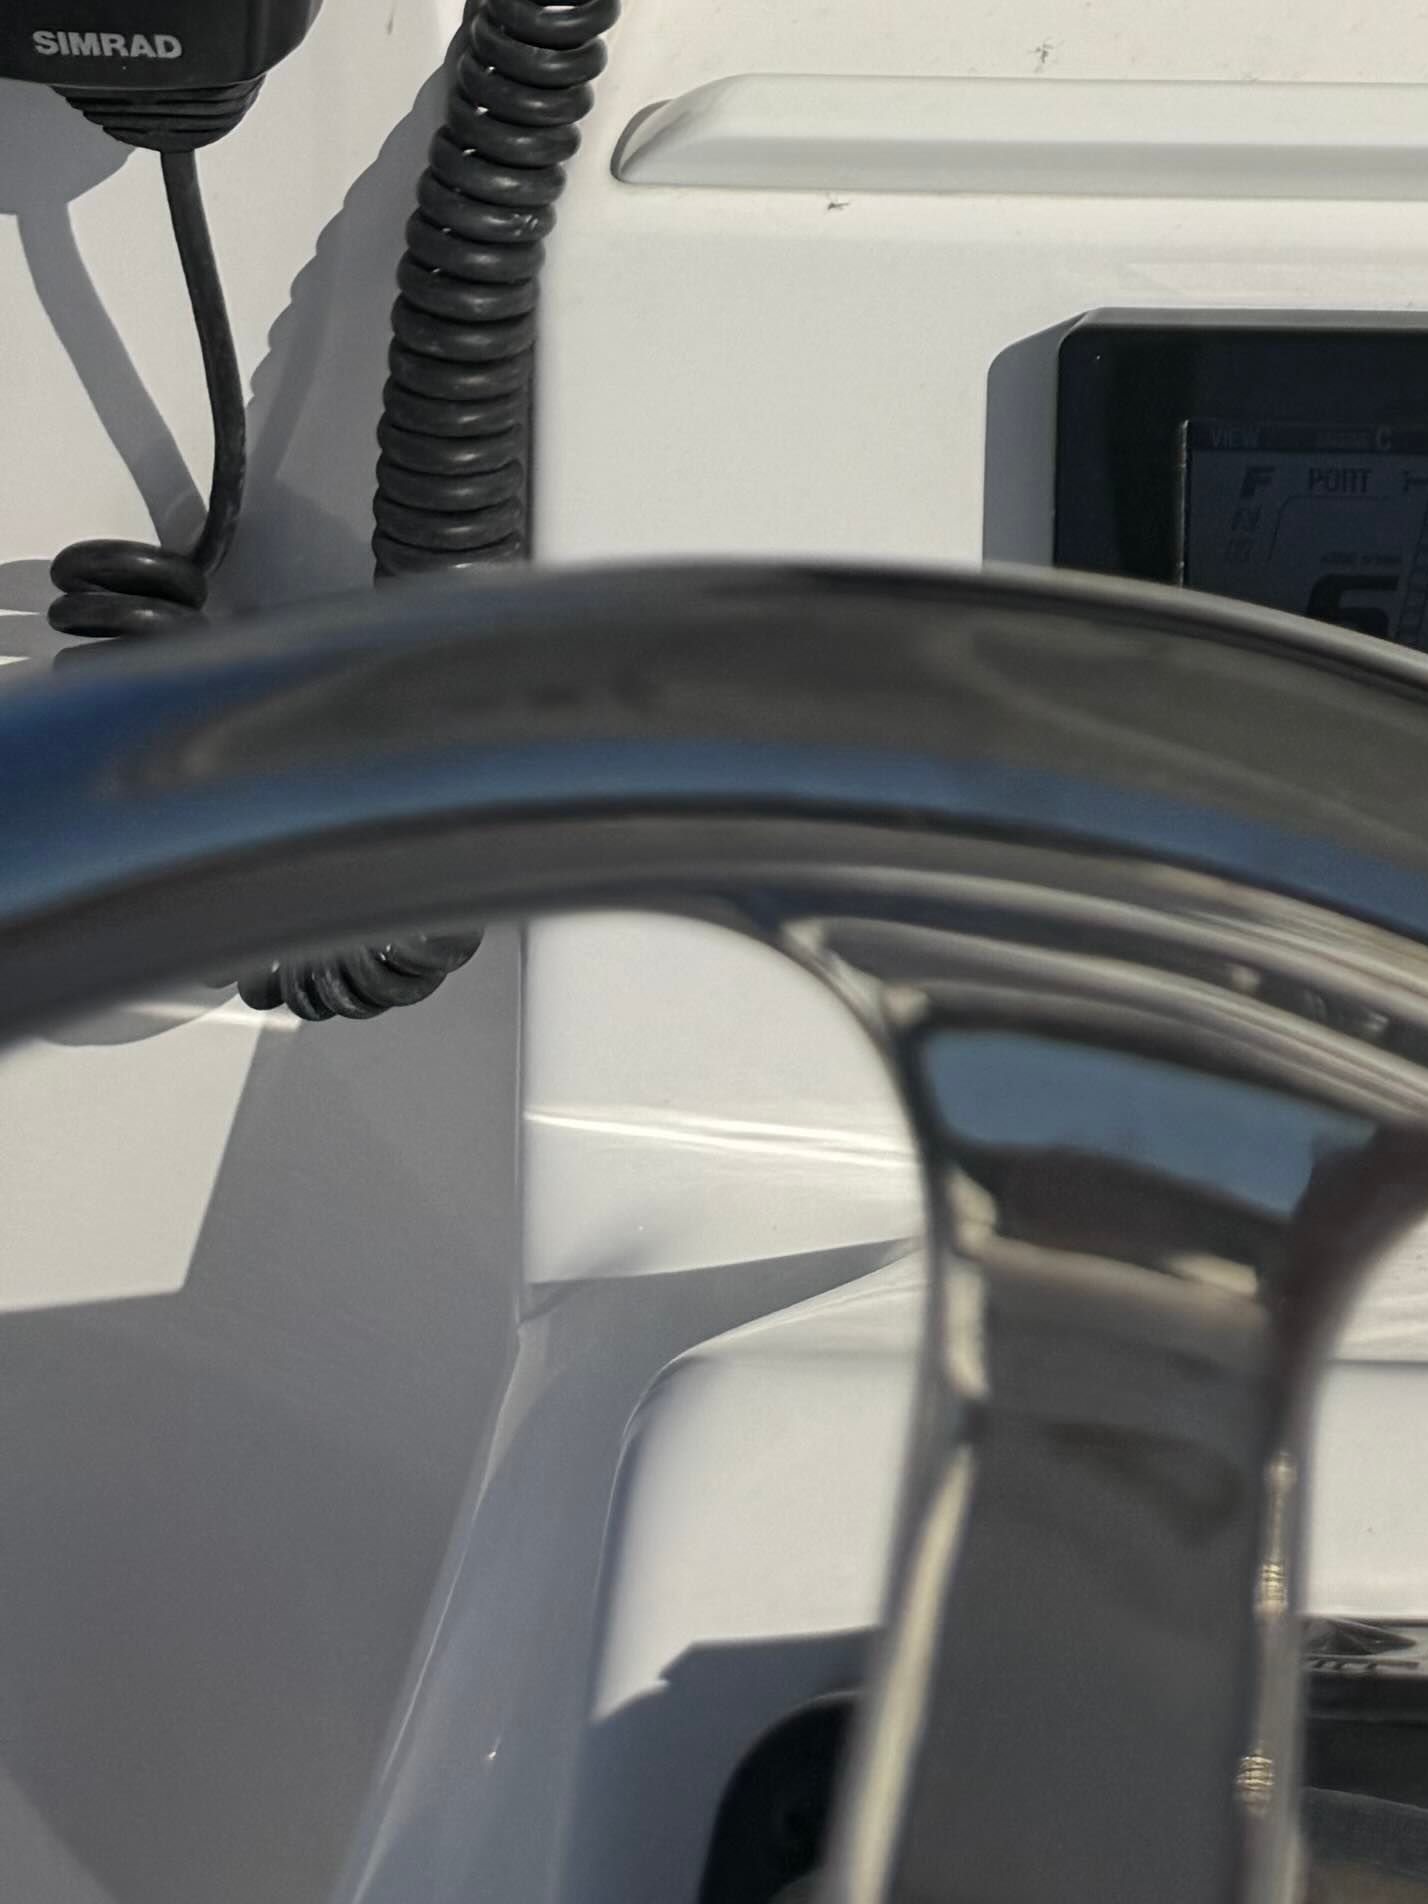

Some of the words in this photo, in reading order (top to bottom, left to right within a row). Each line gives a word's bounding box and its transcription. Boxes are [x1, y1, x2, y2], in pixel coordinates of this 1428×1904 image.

[32, 30, 184, 61] SIMRAD
[1240, 465, 1277, 497] F
[1308, 467, 1372, 493] PORT
